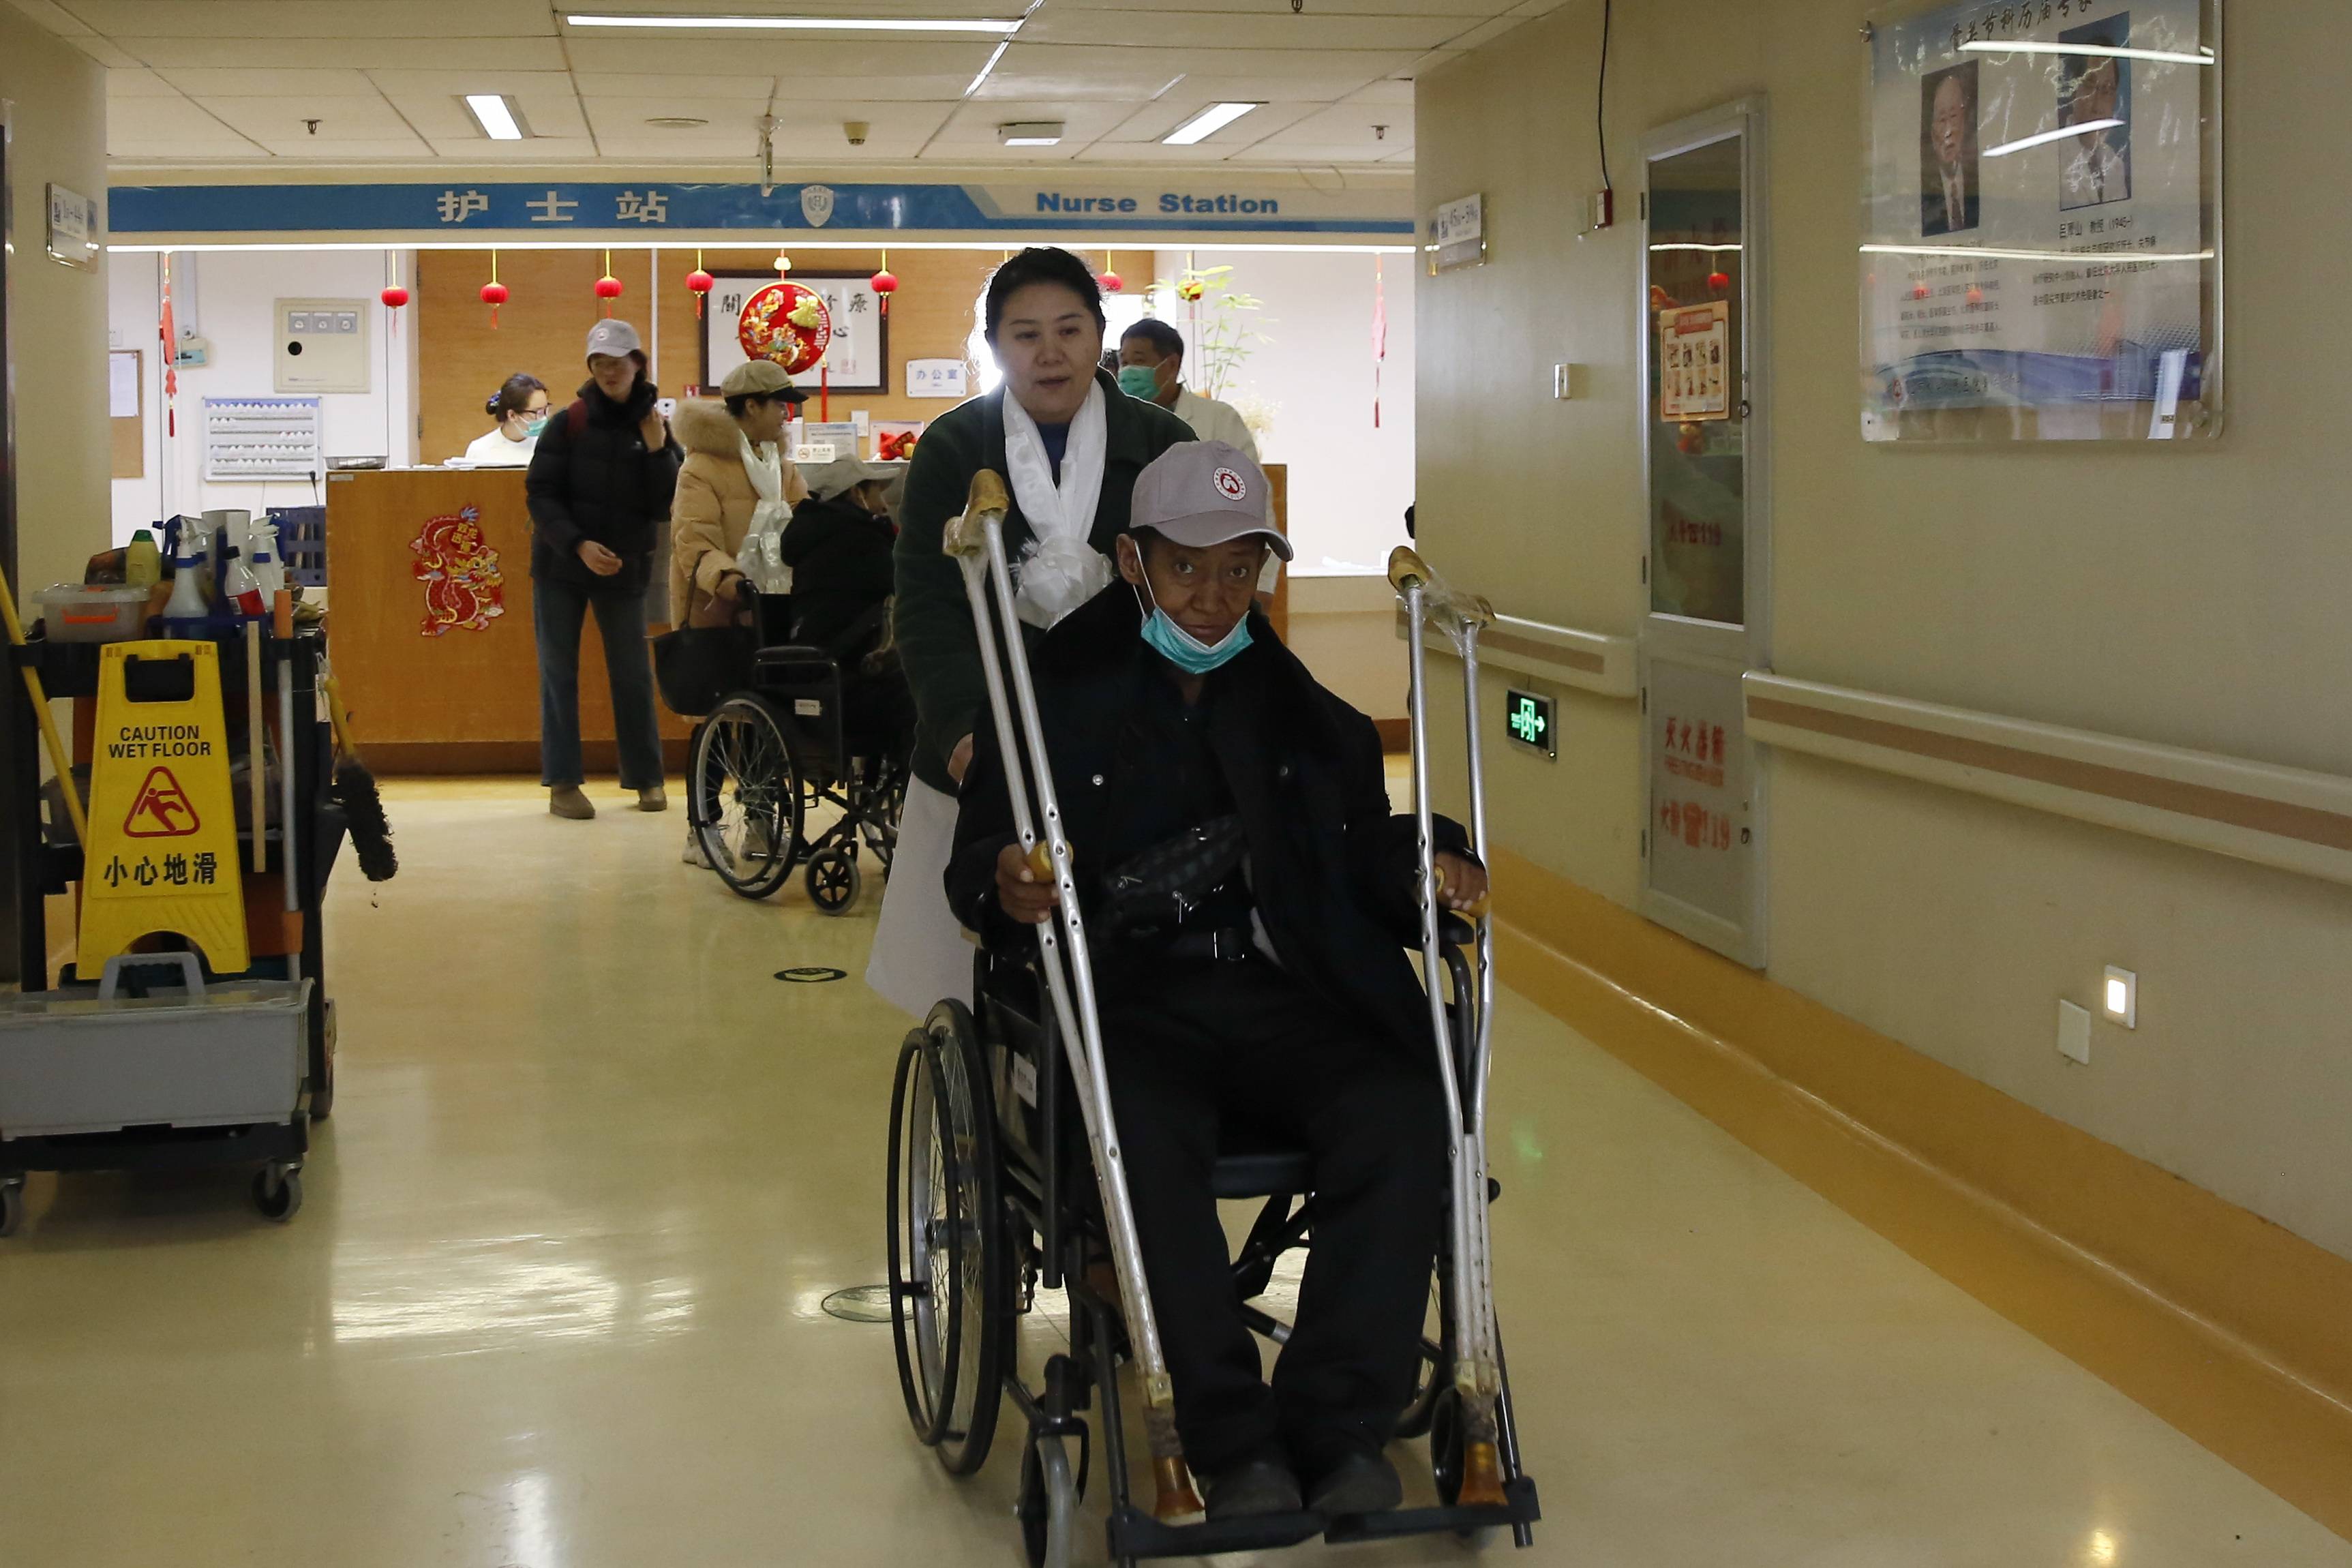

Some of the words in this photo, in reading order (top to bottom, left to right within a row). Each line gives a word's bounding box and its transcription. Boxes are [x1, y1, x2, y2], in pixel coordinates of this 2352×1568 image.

[437, 191, 669, 222] 护士站
[1037, 193, 1137, 213] Nurse
[1160, 194, 1279, 213] Station
[916, 369, 958, 380] 办公室
[120, 725, 200, 741] CAUTION
[109, 743, 147, 758] WET
[153, 742, 211, 757] FLOOR
[104, 851, 217, 888] 小心地滑
